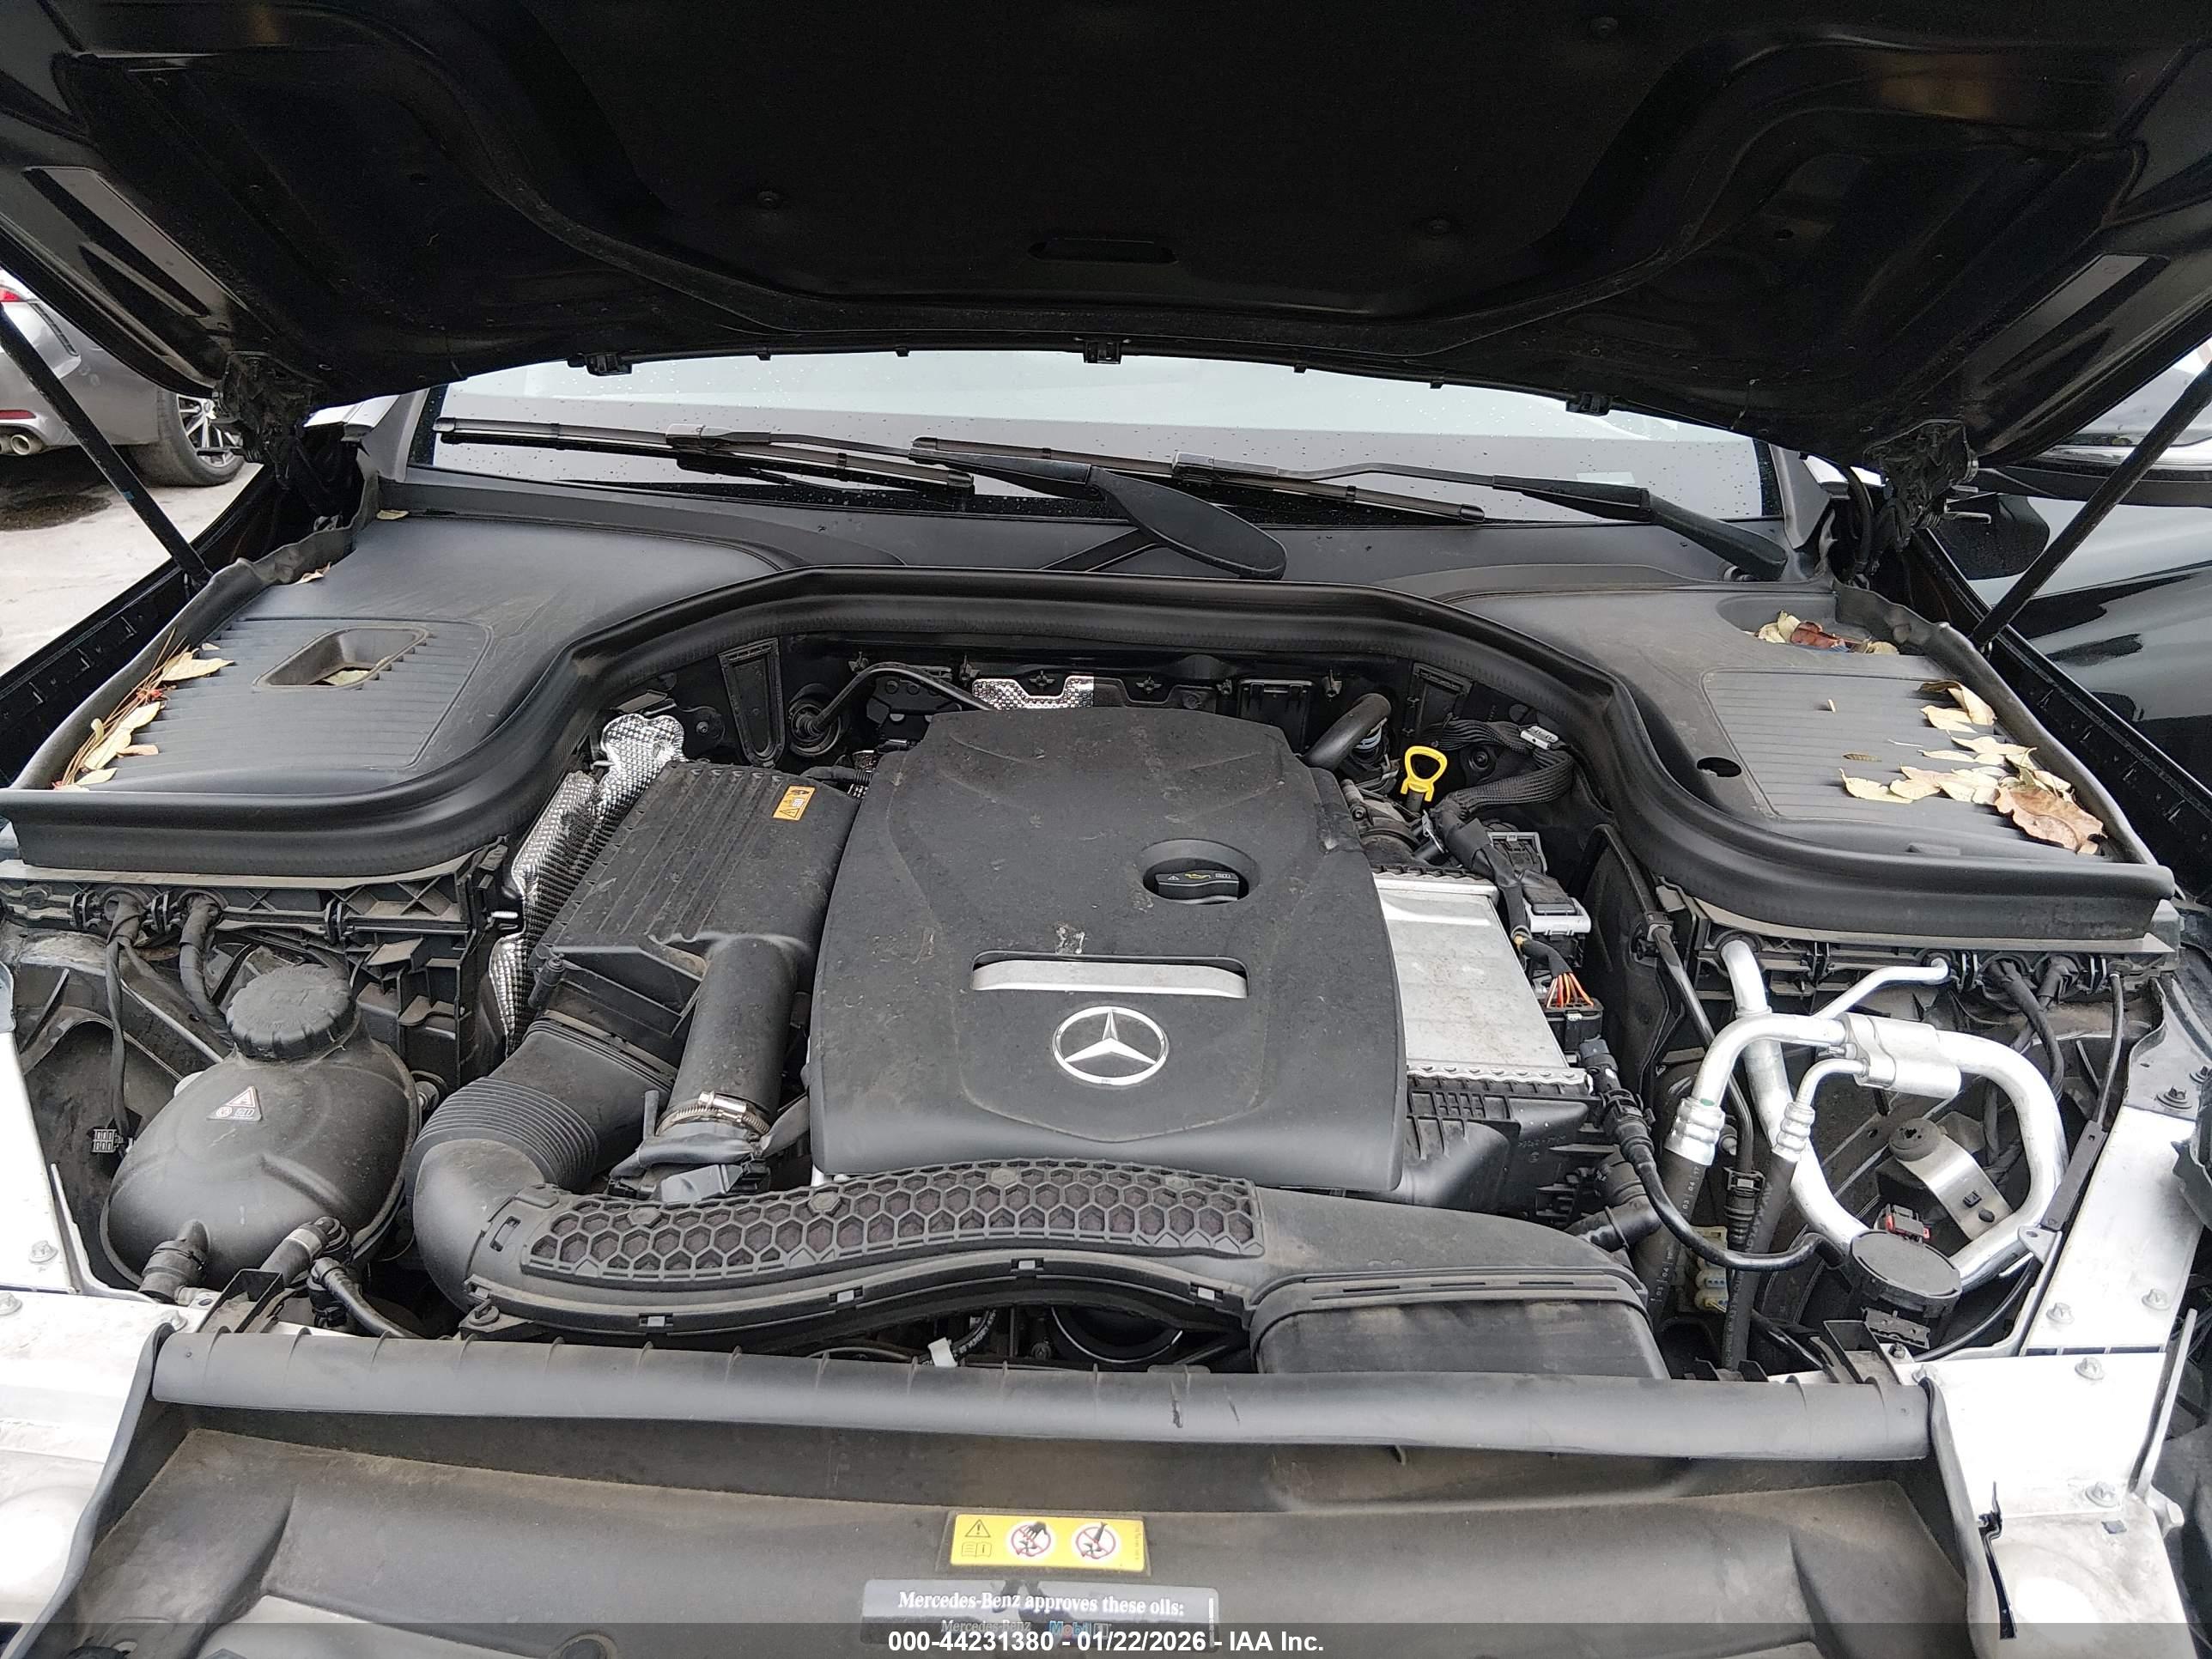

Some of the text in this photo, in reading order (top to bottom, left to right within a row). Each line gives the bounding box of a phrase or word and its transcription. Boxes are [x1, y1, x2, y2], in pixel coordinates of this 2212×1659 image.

[898, 1591, 1020, 1608] Mercedes-Benz
[1024, 1595, 1098, 1613] approves
[1102, 1595, 1147, 1613] these
[940, 1620, 1031, 1632] Mercedes-Benz
